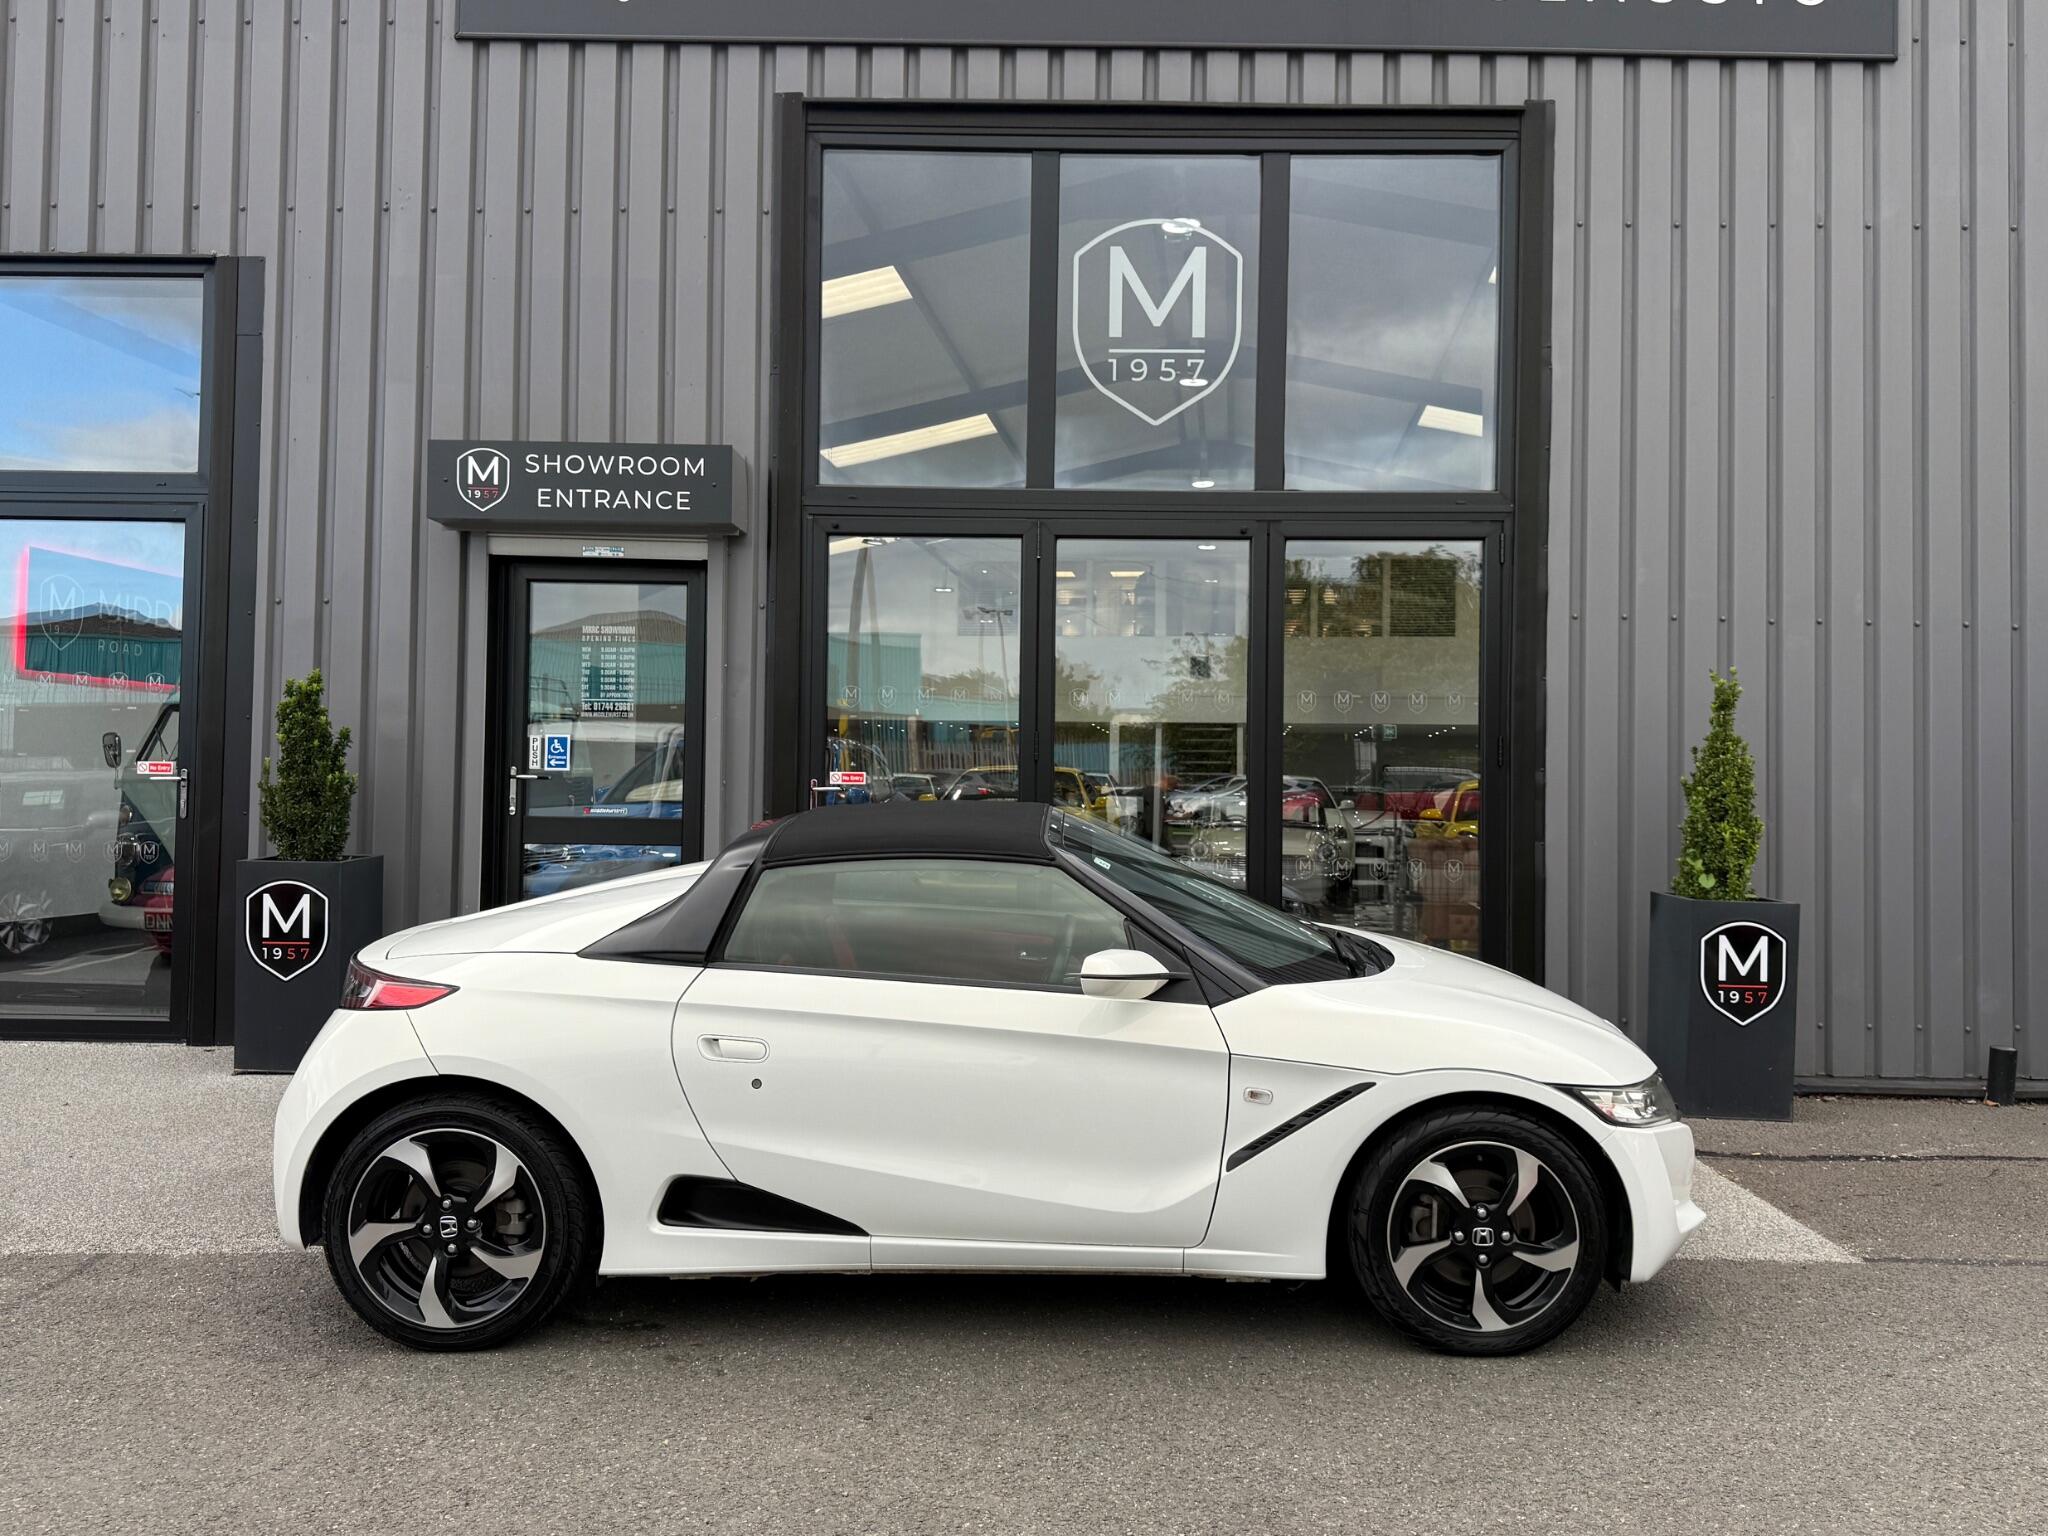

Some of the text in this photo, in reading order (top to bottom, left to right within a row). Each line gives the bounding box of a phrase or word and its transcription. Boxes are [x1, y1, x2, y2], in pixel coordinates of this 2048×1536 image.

[1109, 246, 1206, 338] M
[1108, 359, 1204, 382] 1957
[467, 455, 499, 485] M
[525, 454, 705, 477] SHOWROOM
[467, 489, 499, 499] 1957
[537, 488, 691, 510] ENTRANCE
[98, 639, 142, 657] ROAD
[531, 738, 539, 766] PUSH
[262, 893, 310, 938] M
[262, 947, 310, 960] 1957
[1718, 934, 1768, 982] M
[1718, 990, 1768, 1004] 1957
